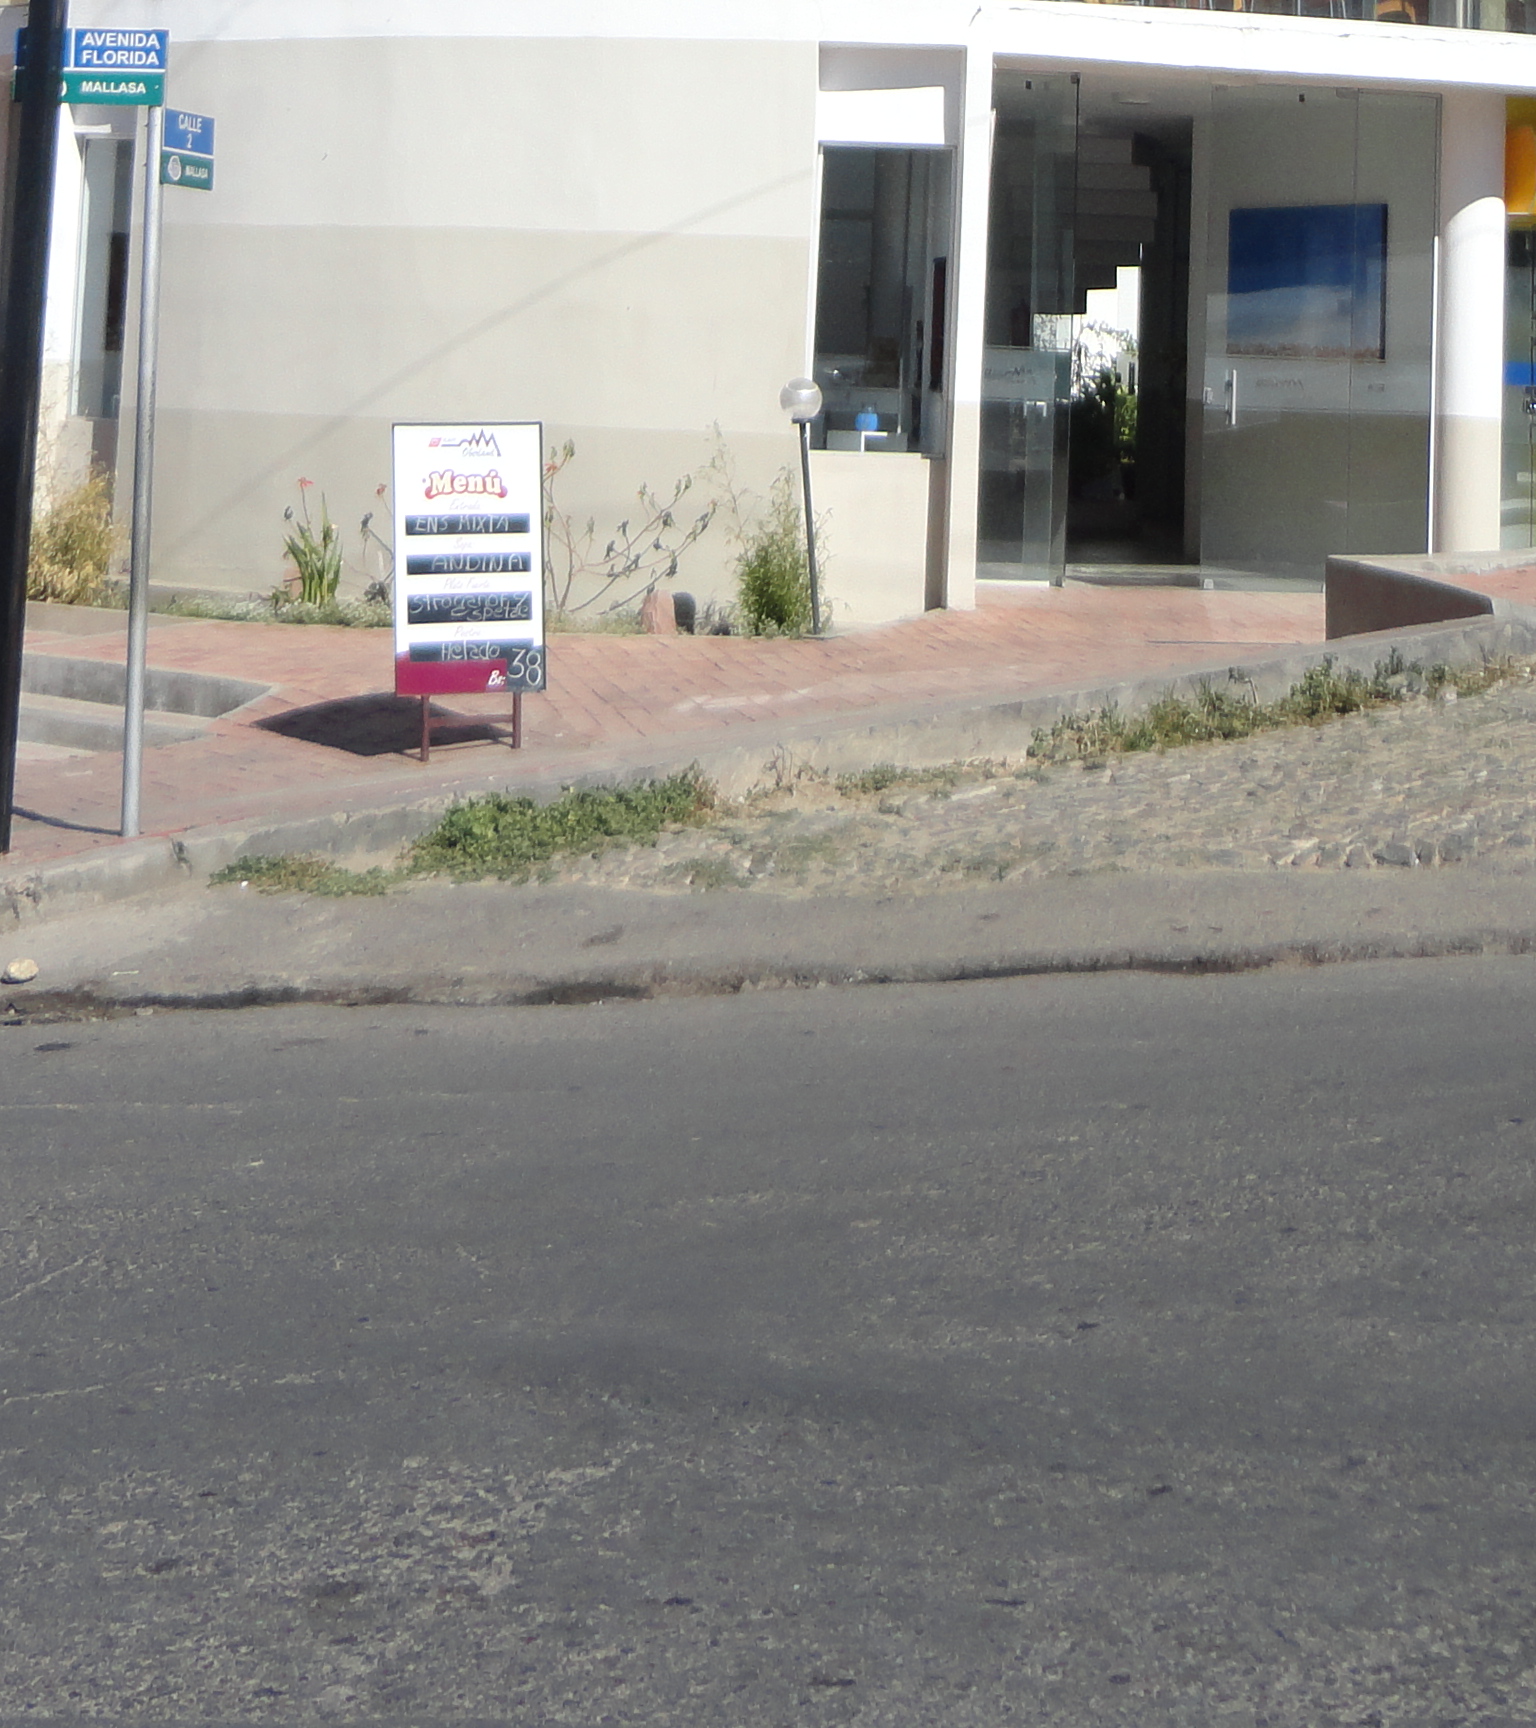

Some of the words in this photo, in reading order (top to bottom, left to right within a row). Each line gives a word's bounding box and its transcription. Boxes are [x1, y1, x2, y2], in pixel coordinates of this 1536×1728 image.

[82, 32, 161, 49] AVENIDA
[82, 49, 160, 66] FLORIDA
[81, 80, 146, 94] MALLASA
[178, 113, 203, 133] CALLE
[186, 133, 193, 149] 2
[429, 469, 502, 496] Menú
[415, 515, 449, 532] ENS
[458, 514, 510, 534] MIXTA
[432, 553, 524, 572] ANDINA
[507, 648, 542, 686] 38
